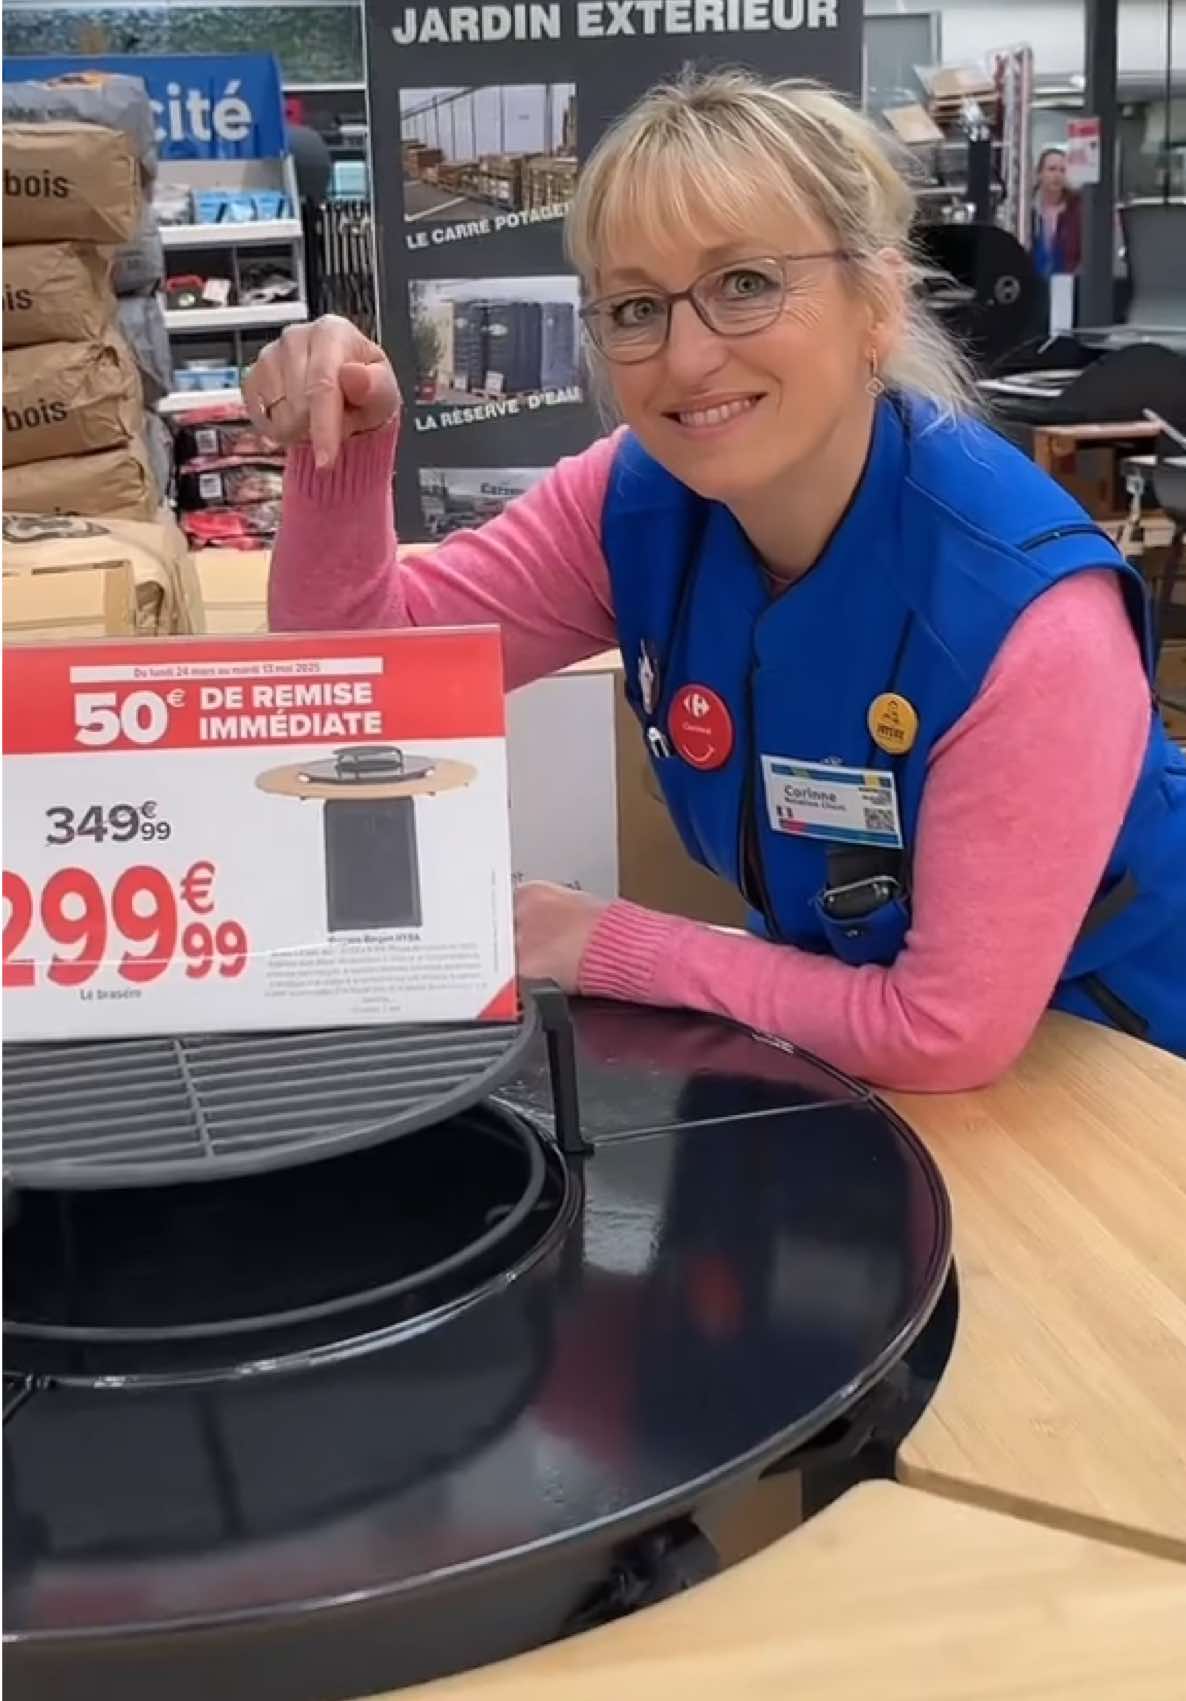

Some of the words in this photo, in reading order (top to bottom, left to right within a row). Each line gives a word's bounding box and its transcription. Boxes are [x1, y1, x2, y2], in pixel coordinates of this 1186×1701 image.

[392, 4, 561, 45] JARDIN
[577, 0, 838, 38] EXTERIEUR
[406, 232, 429, 249] LE
[3, 398, 68, 431] bois
[415, 415, 438, 431] LA
[200, 686, 244, 710] DE
[253, 682, 373, 709] REMISE
[200, 709, 383, 740] IMMÉDIATE
[784, 784, 837, 802] Corinne
